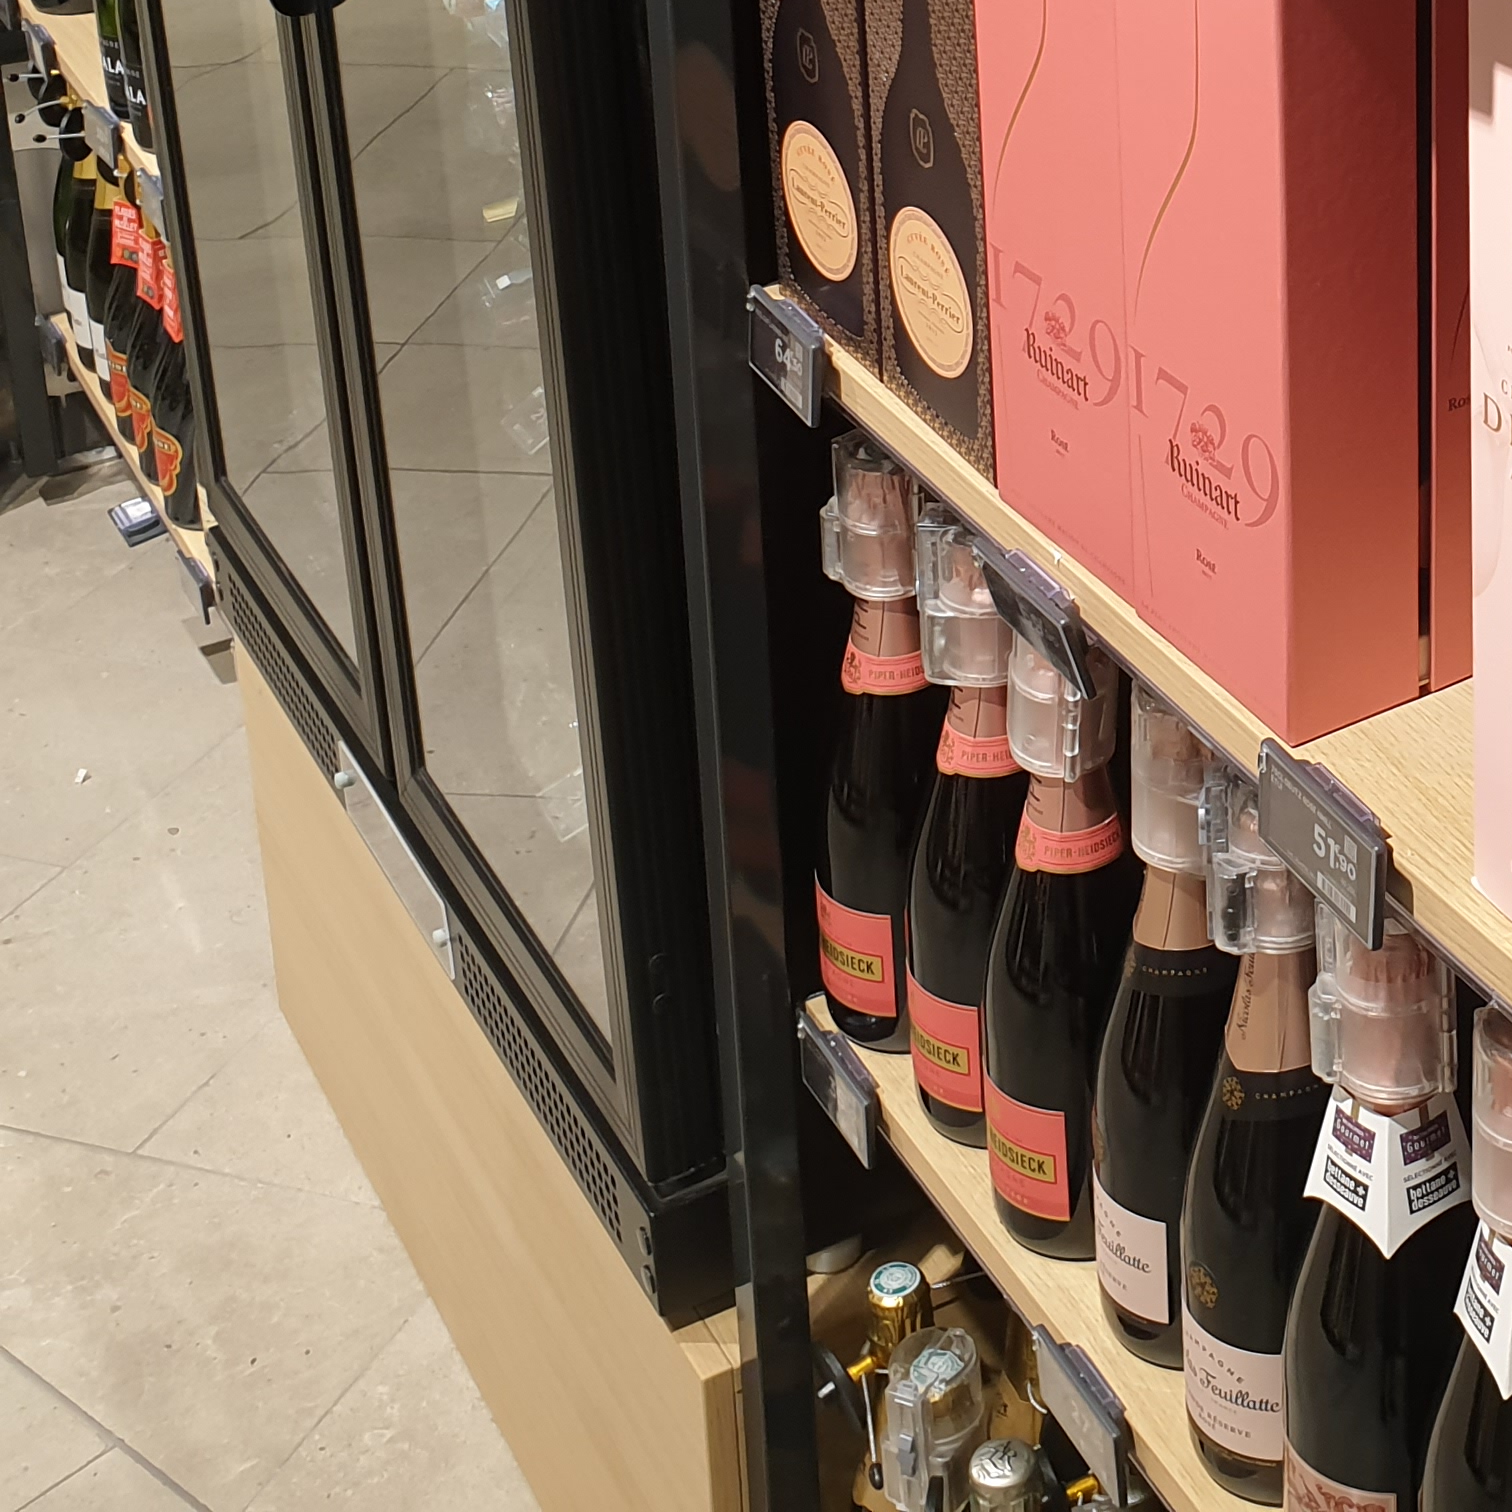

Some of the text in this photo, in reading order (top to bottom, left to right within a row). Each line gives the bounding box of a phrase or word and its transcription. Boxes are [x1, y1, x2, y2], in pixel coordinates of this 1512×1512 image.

[899, 263, 961, 324] Laurent-Perrier
[1023, 327, 1089, 403] Ruinart
[1128, 344, 1281, 528] 1729
[1167, 438, 1242, 522] Ruinart
[1409, 1176, 1446, 1202] bettane
[1199, 1366, 1282, 1414] Feuillatte
